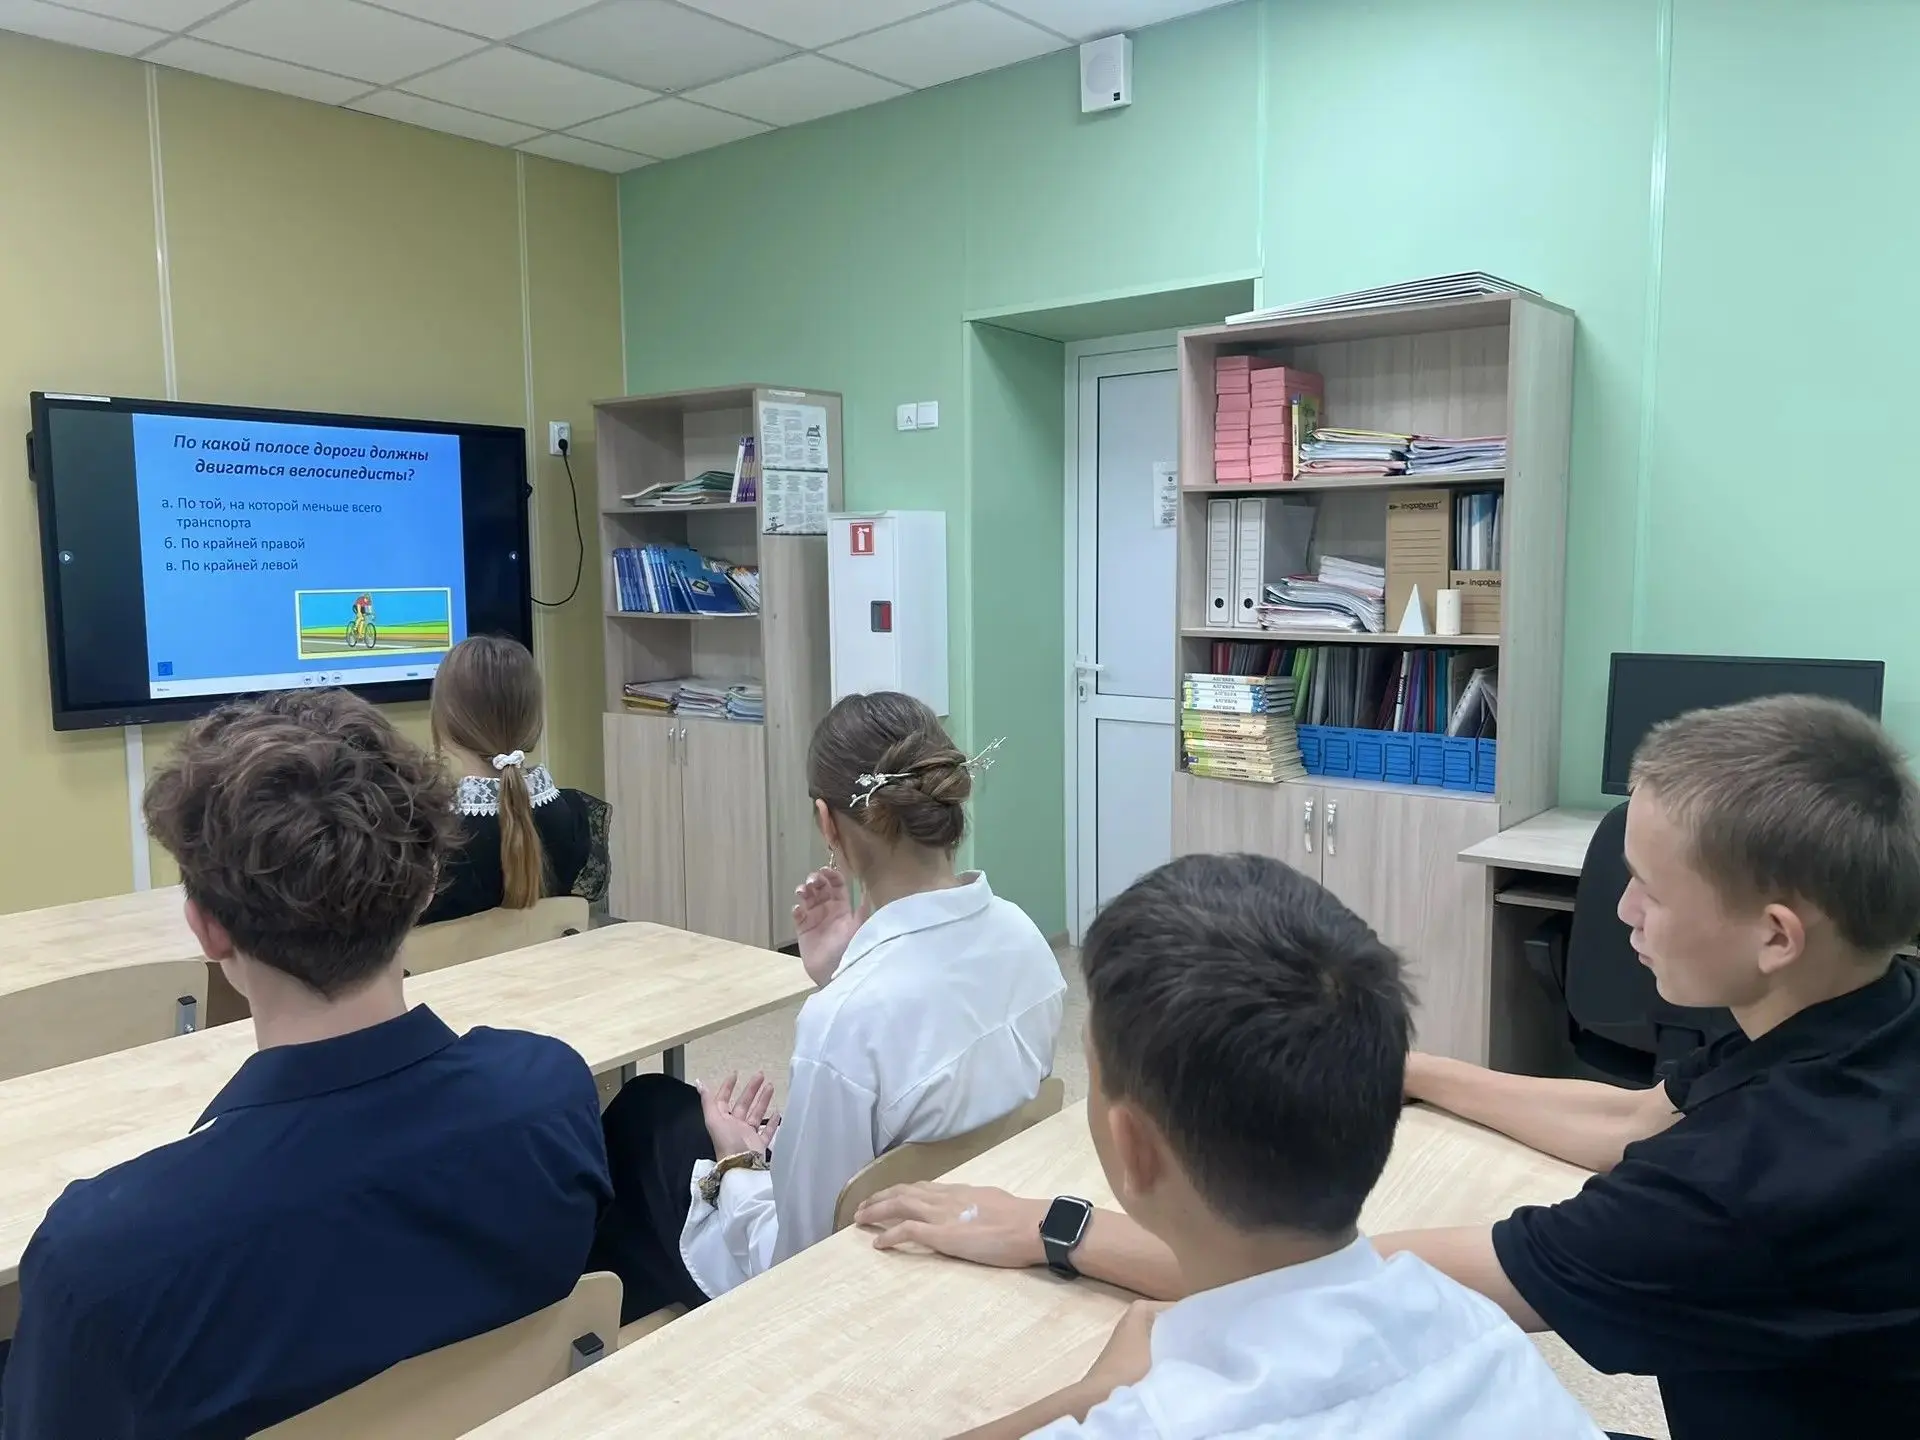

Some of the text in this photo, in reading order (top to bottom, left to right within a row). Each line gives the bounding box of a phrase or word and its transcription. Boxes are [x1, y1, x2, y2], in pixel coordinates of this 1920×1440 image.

[173, 434, 430, 461] По какой полосе дороги должны
[194, 458, 416, 481] двигаться велосипедисты?
[161, 497, 382, 514] а. По той, на которой меньше всего
[176, 516, 252, 530] транспорта
[164, 536, 305, 551] б. По крайней правой
[165, 558, 299, 573] в. По крайней левой
